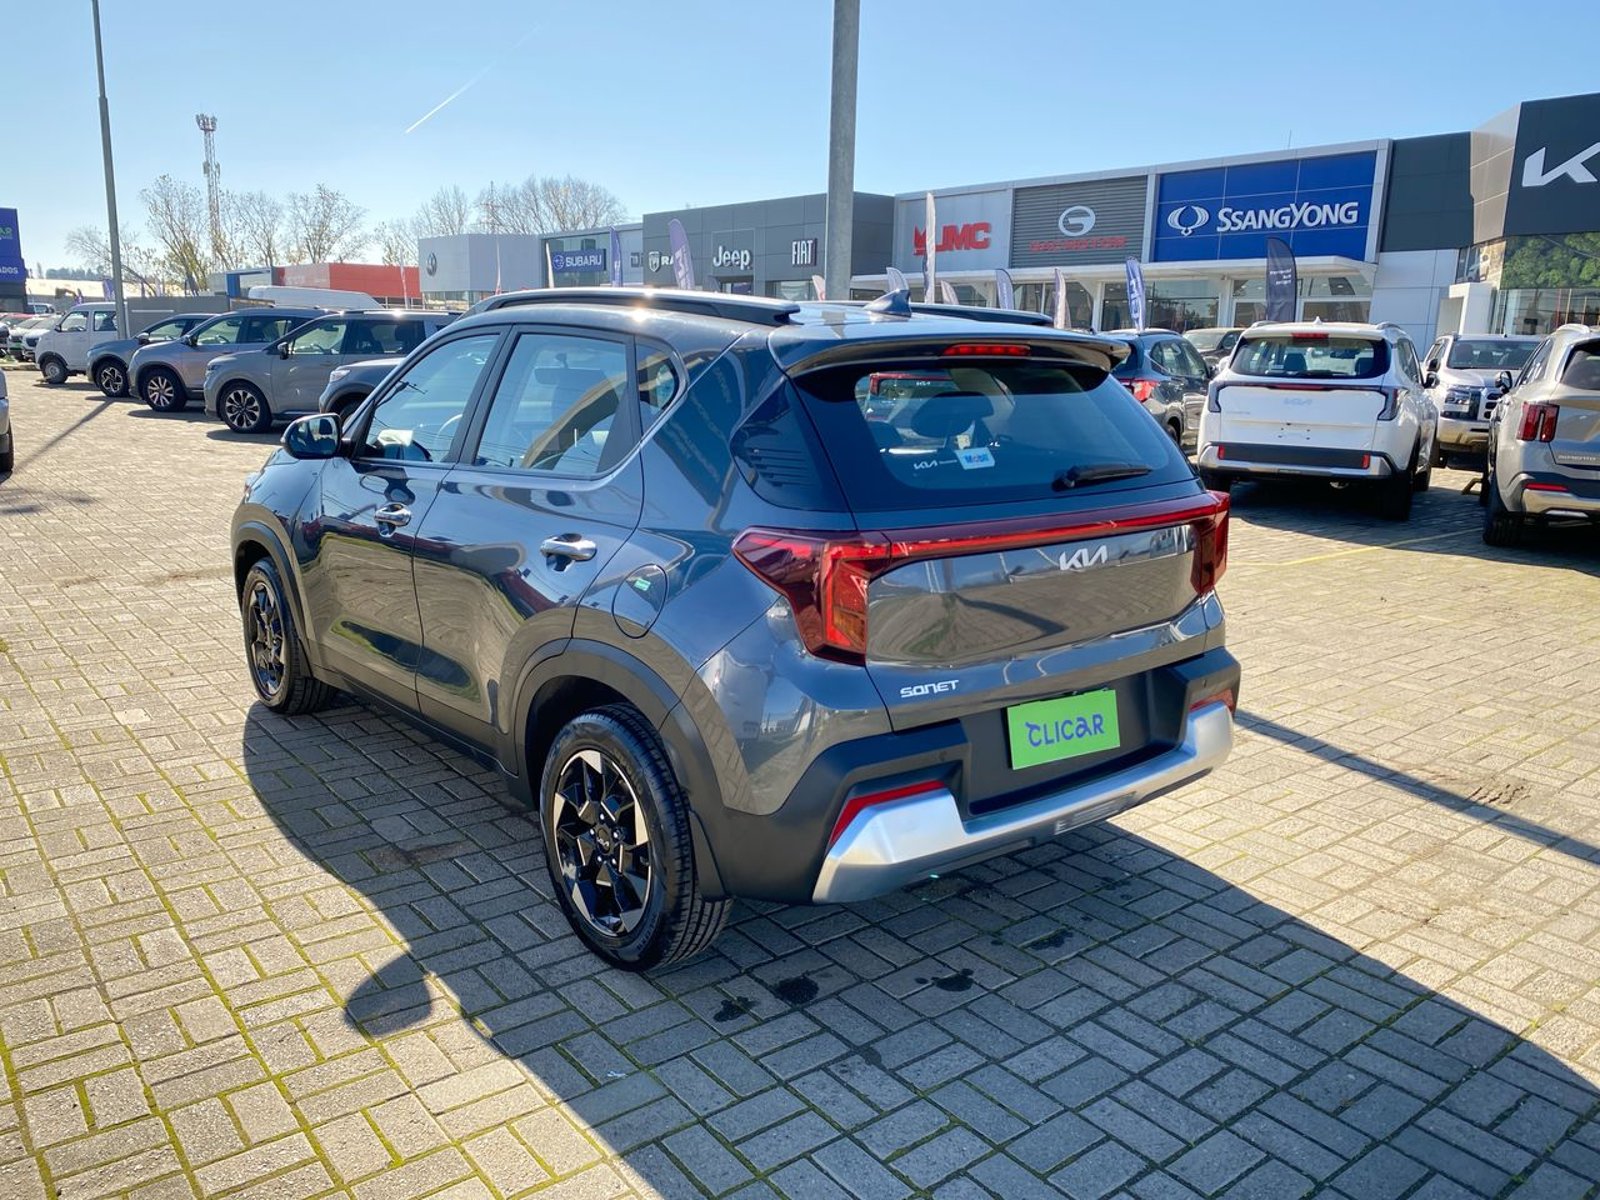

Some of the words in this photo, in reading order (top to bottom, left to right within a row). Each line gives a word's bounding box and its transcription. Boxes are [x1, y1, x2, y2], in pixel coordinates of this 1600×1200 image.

[935, 222, 992, 252] JMC
[565, 254, 602, 267] SUBARU
[713, 245, 751, 270] Jeep
[792, 240, 814, 265] FIAT
[1059, 545, 1108, 571] KIA
[900, 679, 960, 698] SONET
